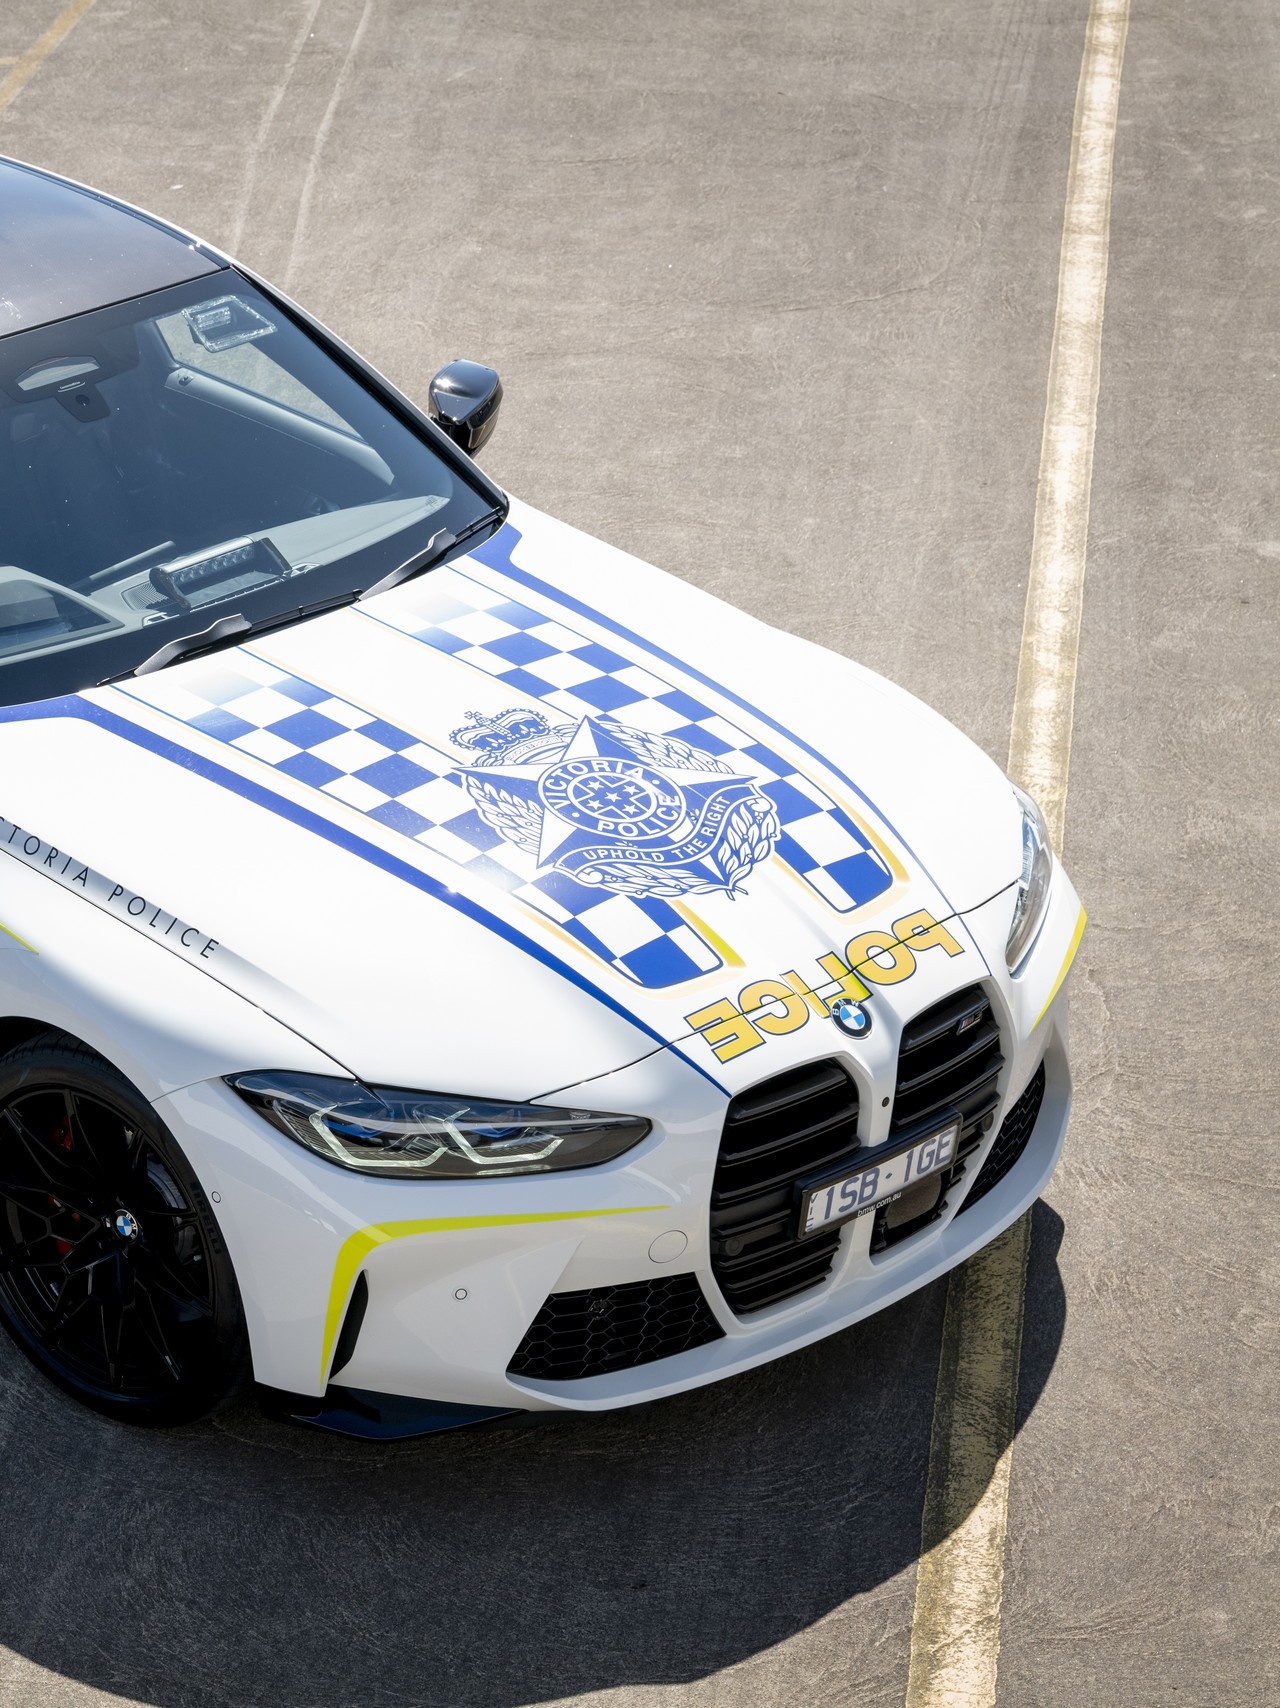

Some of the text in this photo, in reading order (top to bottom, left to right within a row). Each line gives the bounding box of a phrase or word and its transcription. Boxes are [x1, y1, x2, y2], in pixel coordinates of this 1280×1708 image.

[545, 759, 645, 810] VICTORIA
[582, 796, 732, 862] UPHOLD THE RIGHT
[597, 795, 682, 837] POLICE
[107, 884, 220, 959] POLICE
[832, 999, 860, 1017] BMW
[857, 1191, 902, 1217] bmw.com.au
